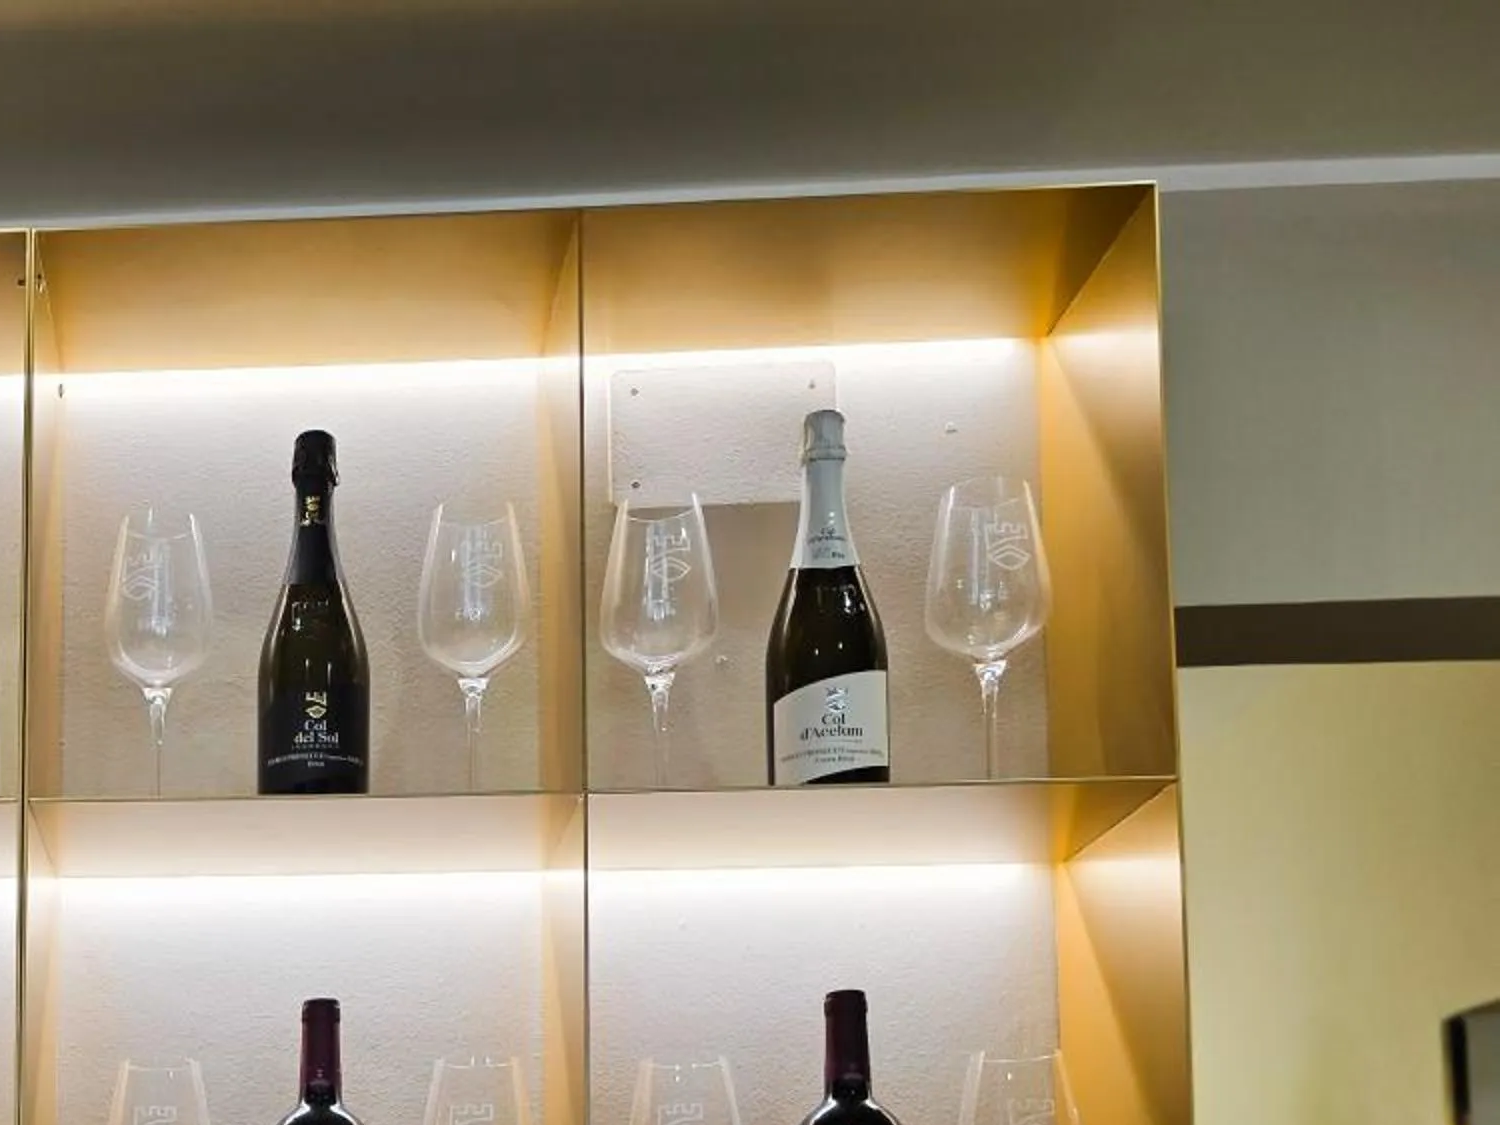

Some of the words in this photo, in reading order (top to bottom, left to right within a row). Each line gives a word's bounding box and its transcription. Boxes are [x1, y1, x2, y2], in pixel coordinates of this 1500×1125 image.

[304, 719, 327, 731] Col
[821, 713, 845, 725] Col
[294, 731, 314, 743] del
[317, 731, 339, 743] Sol
